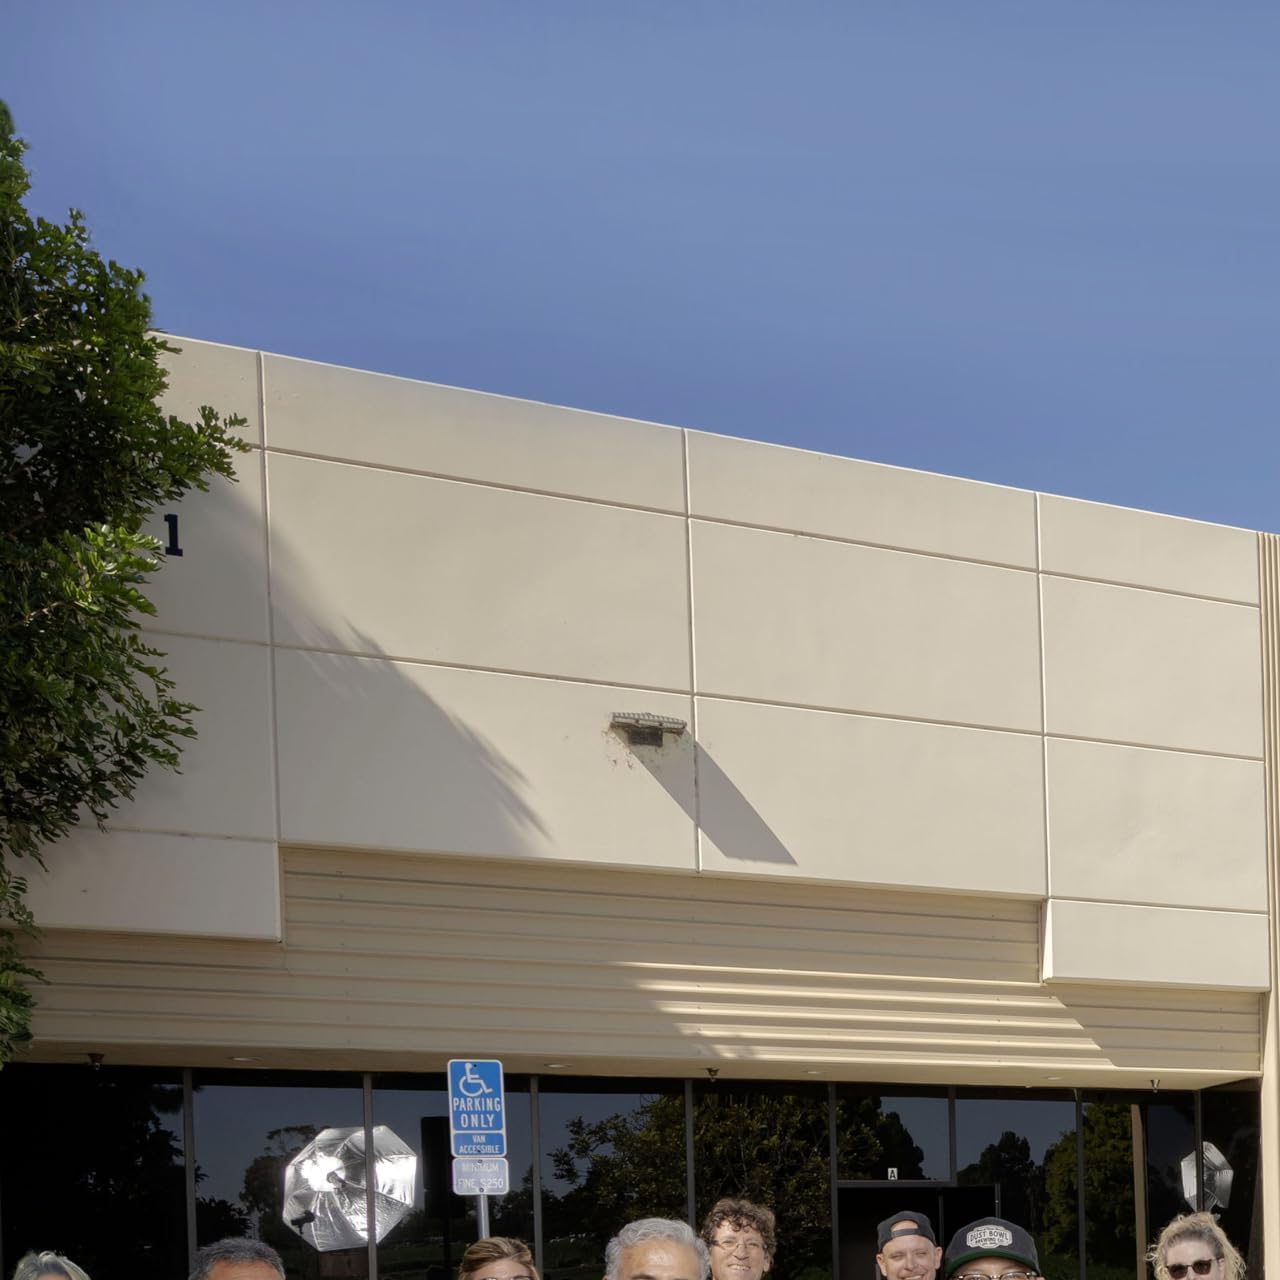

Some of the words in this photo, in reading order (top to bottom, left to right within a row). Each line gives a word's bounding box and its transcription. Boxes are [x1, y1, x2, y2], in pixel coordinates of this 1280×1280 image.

[164, 513, 183, 557] 1
[453, 1097, 501, 1112] PARKING
[461, 1113, 495, 1128] ONLY
[472, 1135, 486, 1143] VAN
[459, 1145, 500, 1154] ACCESSIBLE
[457, 1178, 476, 1189] FINE
[970, 1231, 986, 1241] DUST
[988, 1230, 1009, 1241] BOWL
